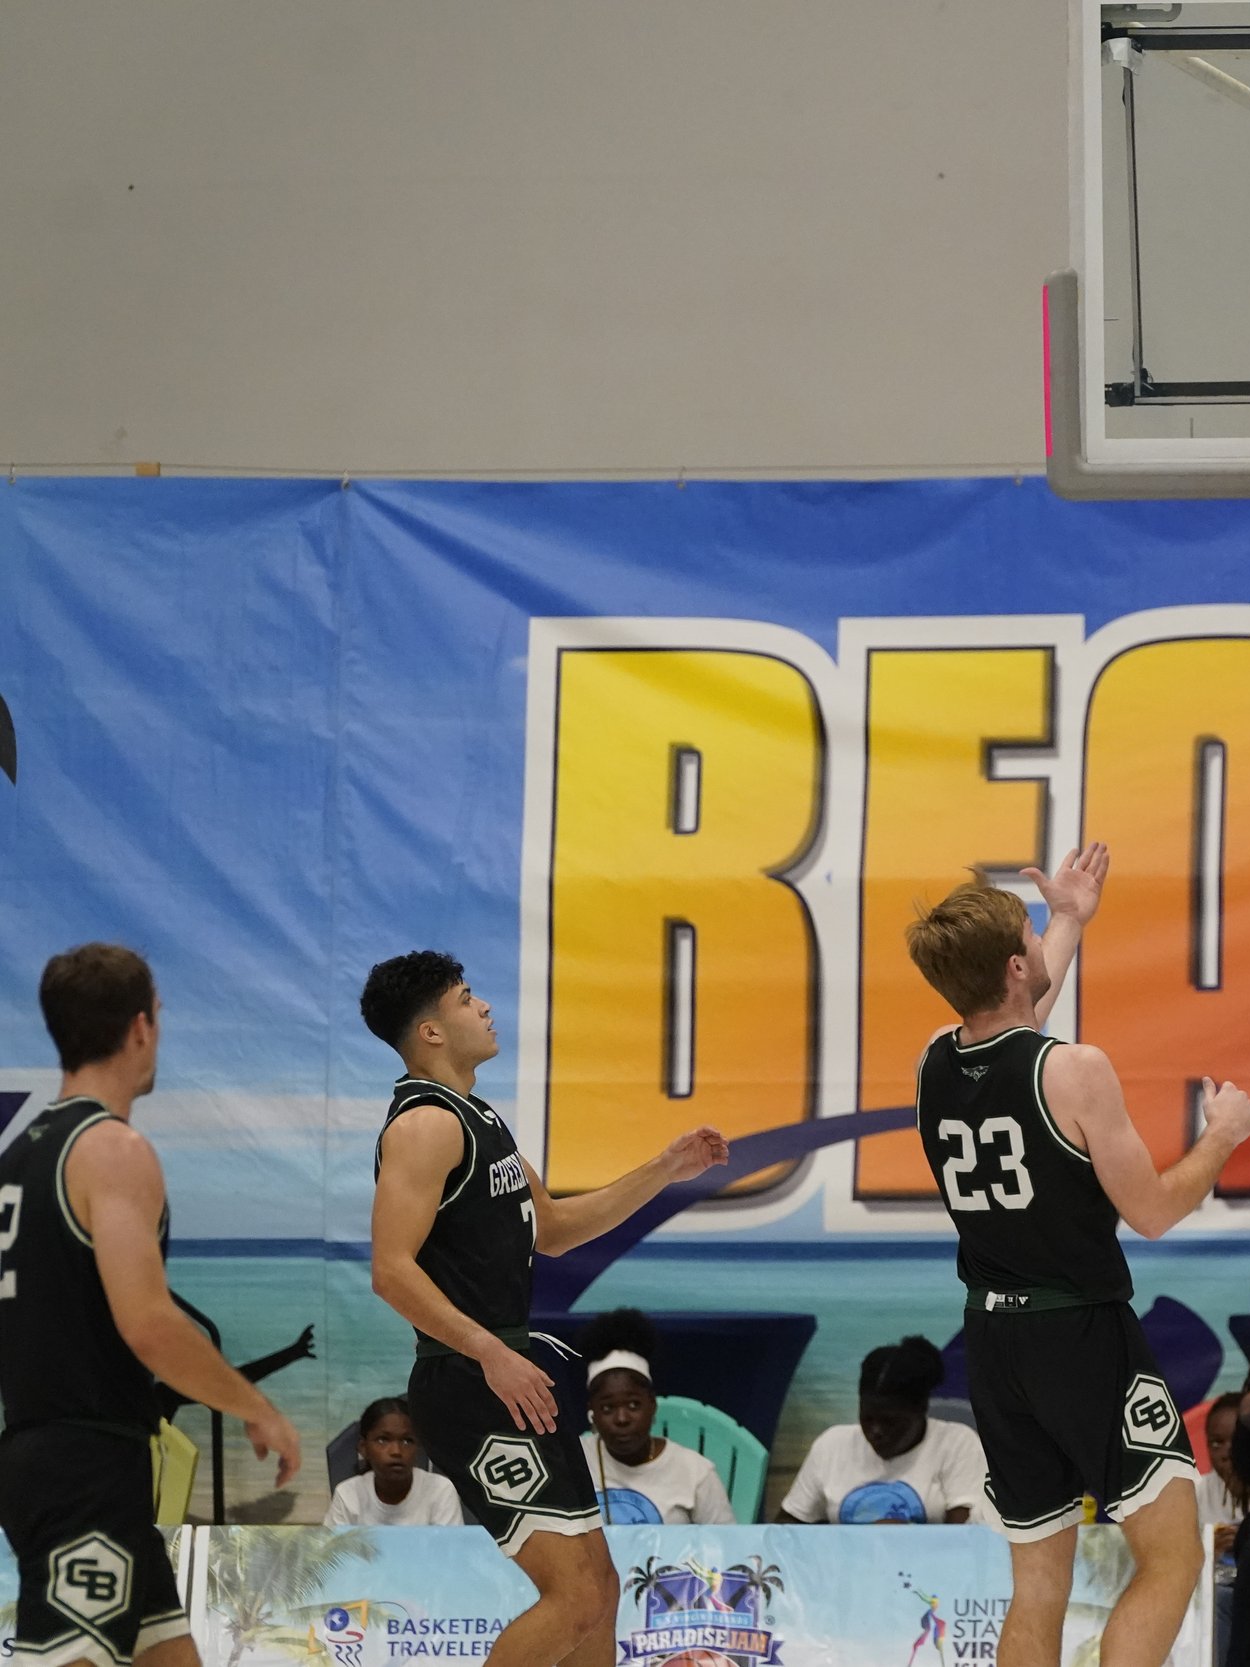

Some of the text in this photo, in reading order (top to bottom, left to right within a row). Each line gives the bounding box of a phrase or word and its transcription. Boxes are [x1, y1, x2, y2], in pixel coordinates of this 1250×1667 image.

[937, 1117, 1035, 1210] 23
[954, 1599, 1011, 1616] UNIT
[387, 1618, 512, 1635] BASKETBA
[953, 1620, 1006, 1638] STA
[387, 1641, 494, 1657] TRAVELER
[953, 1641, 994, 1659] VIR
